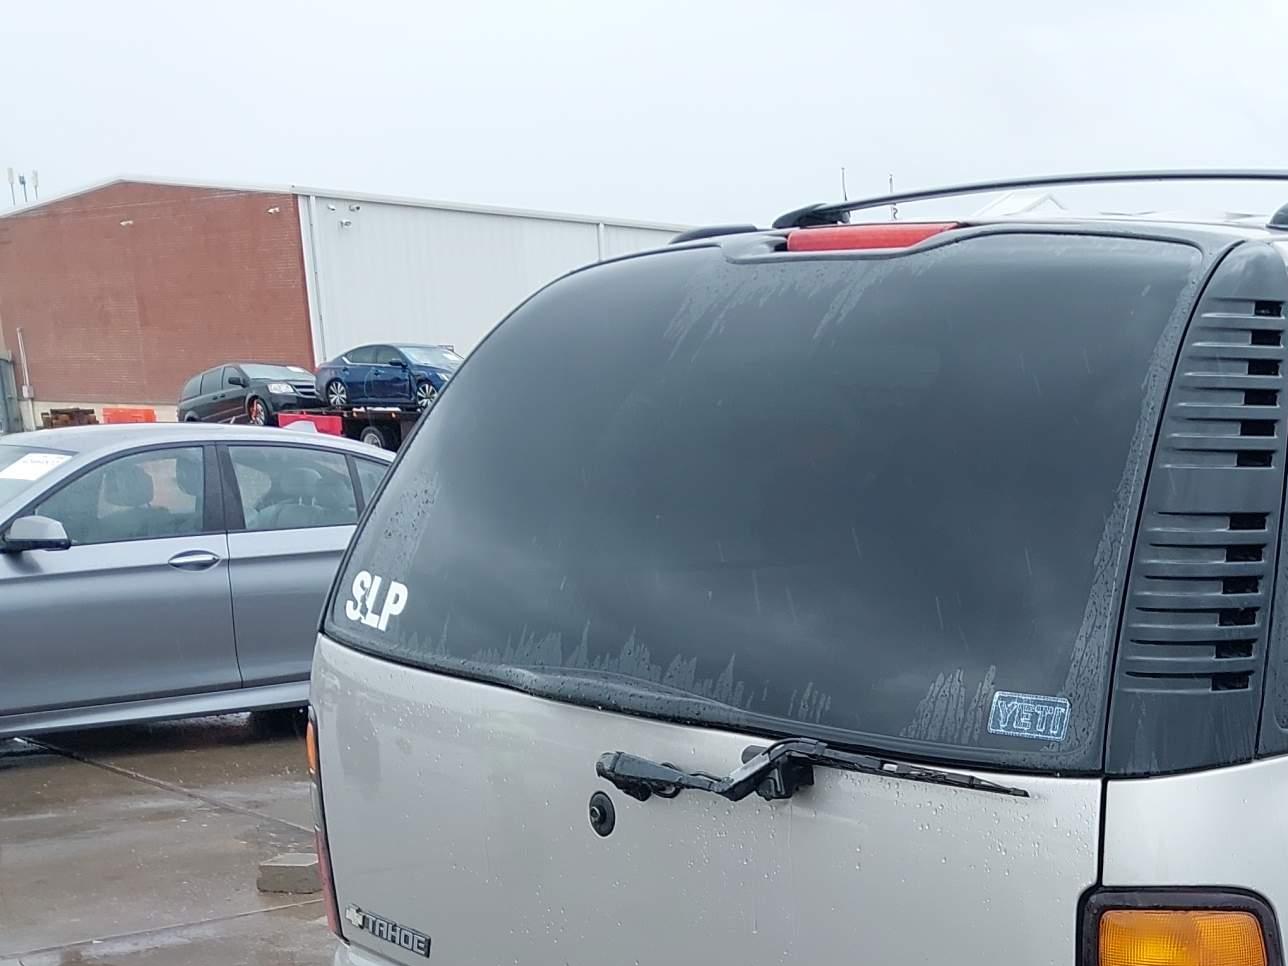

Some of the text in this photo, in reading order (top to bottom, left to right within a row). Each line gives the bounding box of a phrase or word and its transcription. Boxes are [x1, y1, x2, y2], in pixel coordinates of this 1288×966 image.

[345, 570, 409, 631] SLP
[997, 699, 1066, 735] YETI
[365, 914, 427, 956] TAHOE
